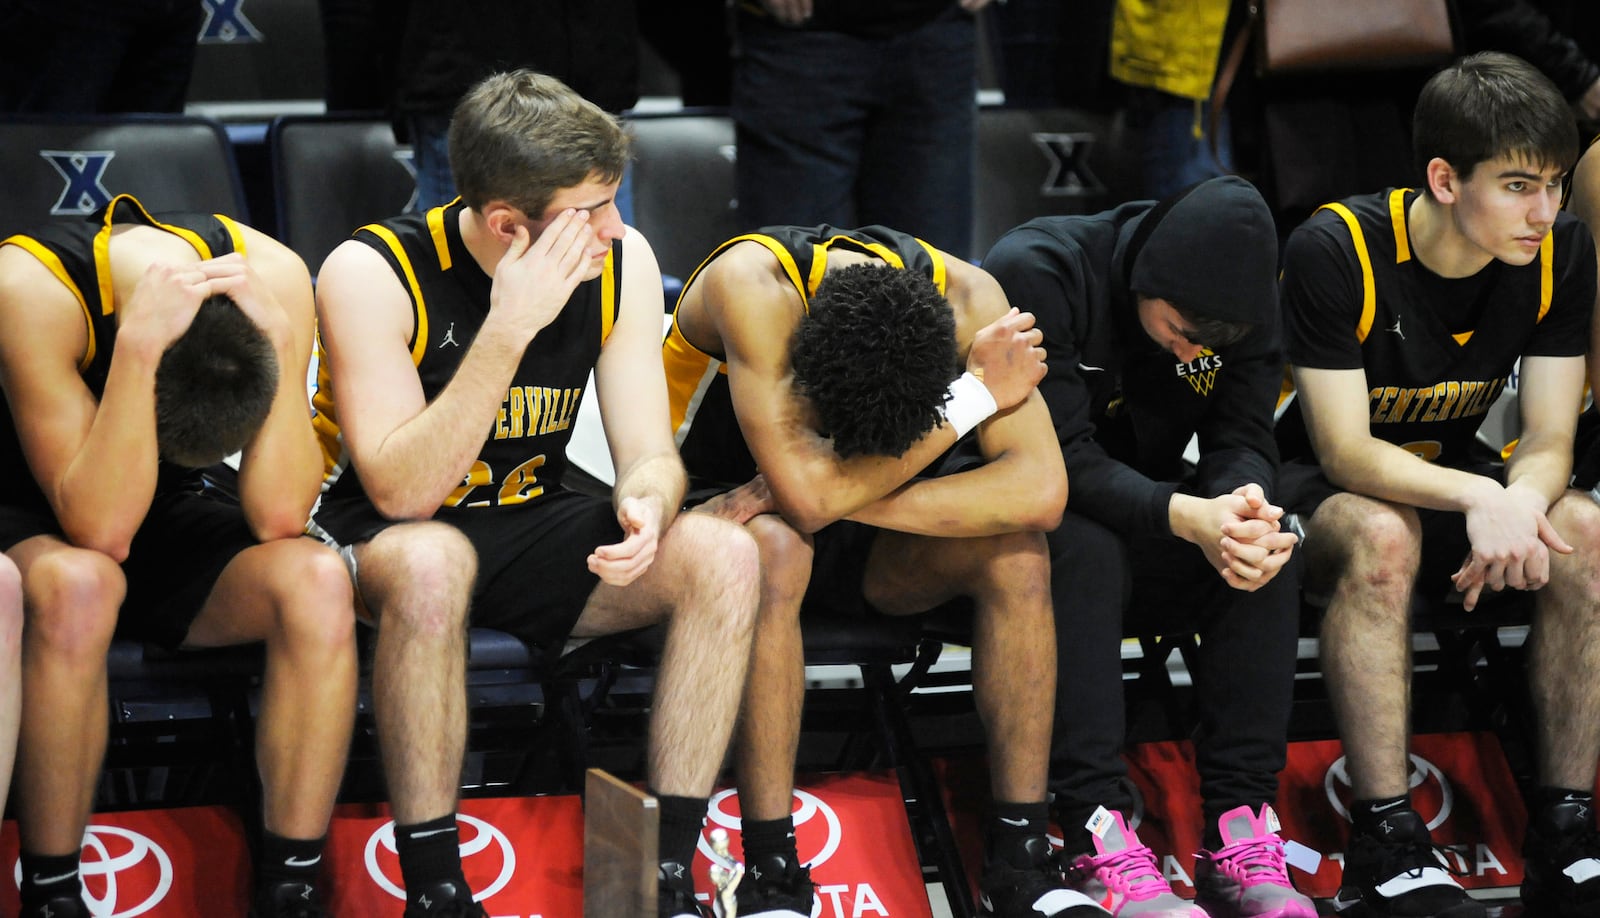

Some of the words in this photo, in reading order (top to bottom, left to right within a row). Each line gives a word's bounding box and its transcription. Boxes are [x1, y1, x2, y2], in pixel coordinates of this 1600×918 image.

[40, 150, 115, 215] X
[1031, 132, 1107, 196] X
[1175, 355, 1223, 376] ELKS
